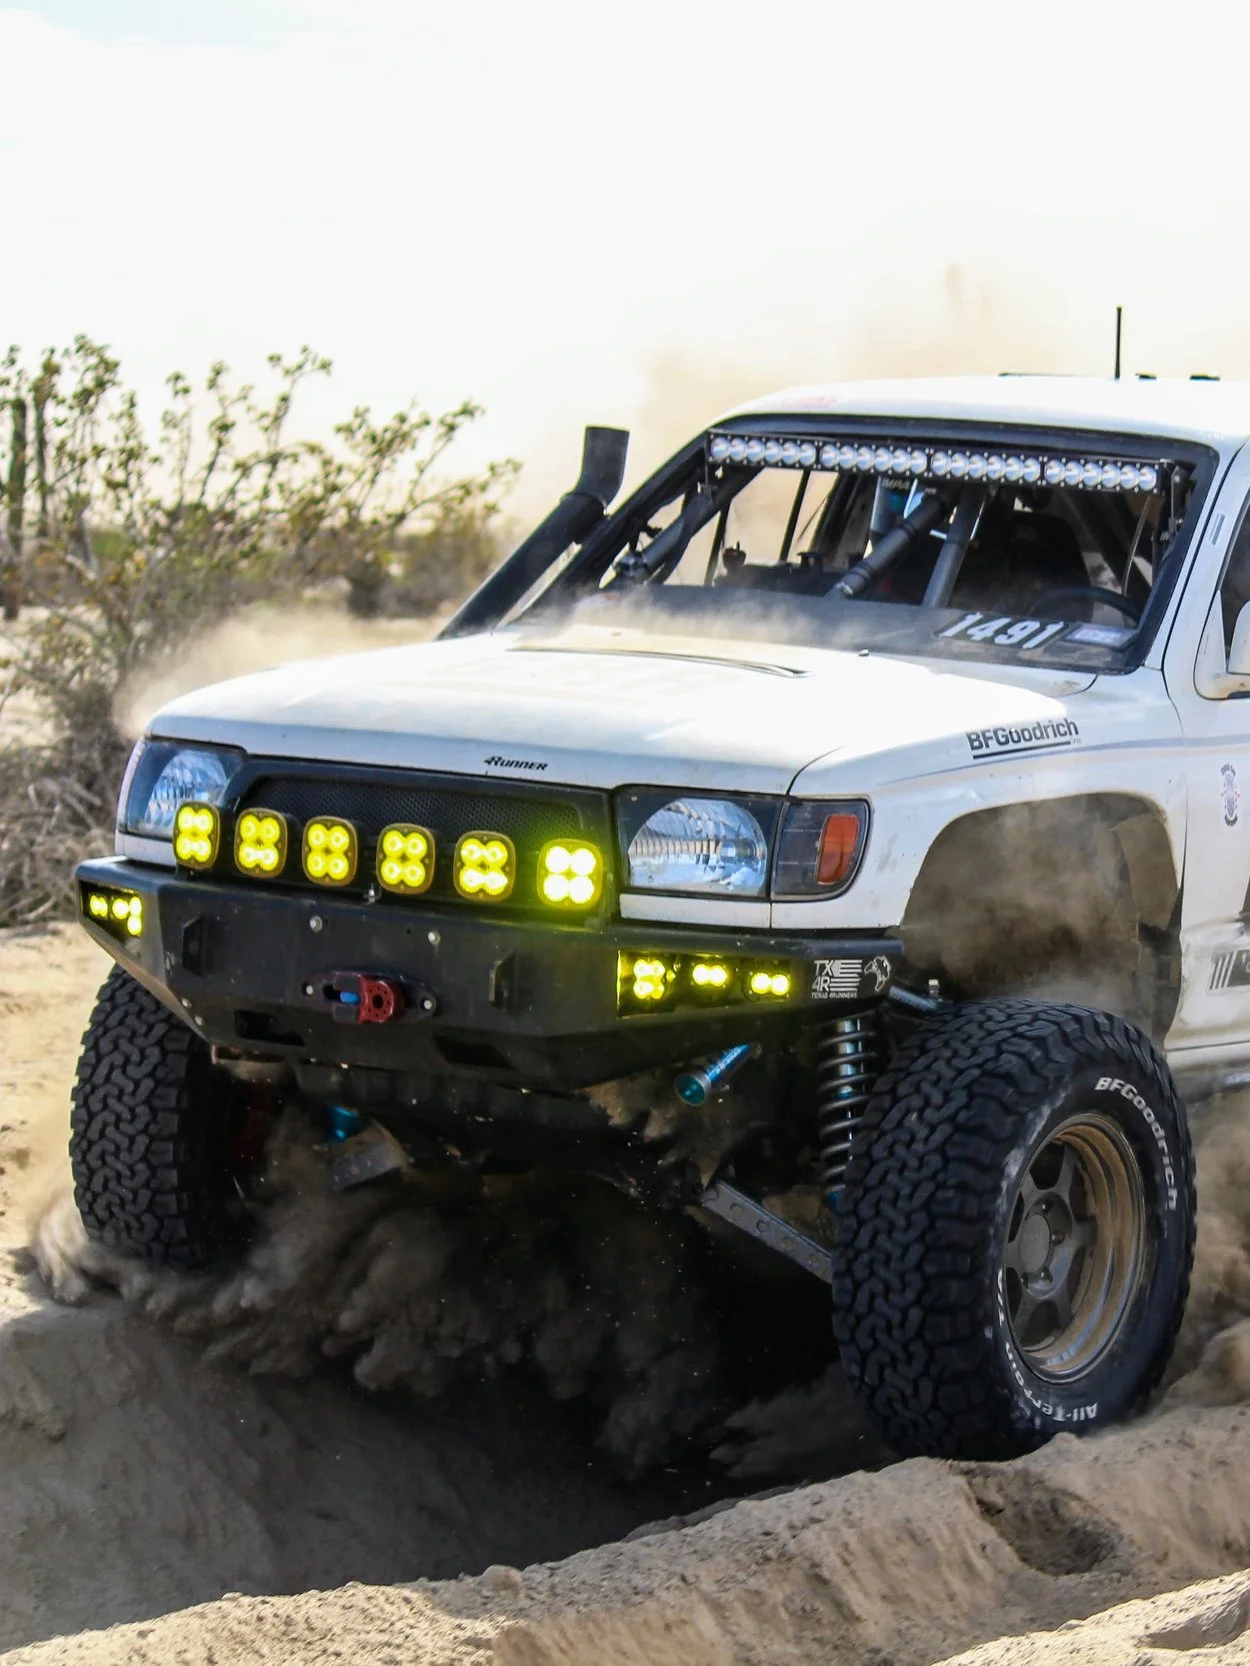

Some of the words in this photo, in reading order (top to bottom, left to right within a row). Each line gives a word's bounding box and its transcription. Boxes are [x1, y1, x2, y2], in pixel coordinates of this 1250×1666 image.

[938, 611, 1064, 650] 1491
[966, 717, 1080, 751] BFGoodrich
[812, 976, 830, 992] 4R
[813, 959, 834, 976] TX
[1094, 1075, 1178, 1211] BFGoodrich
